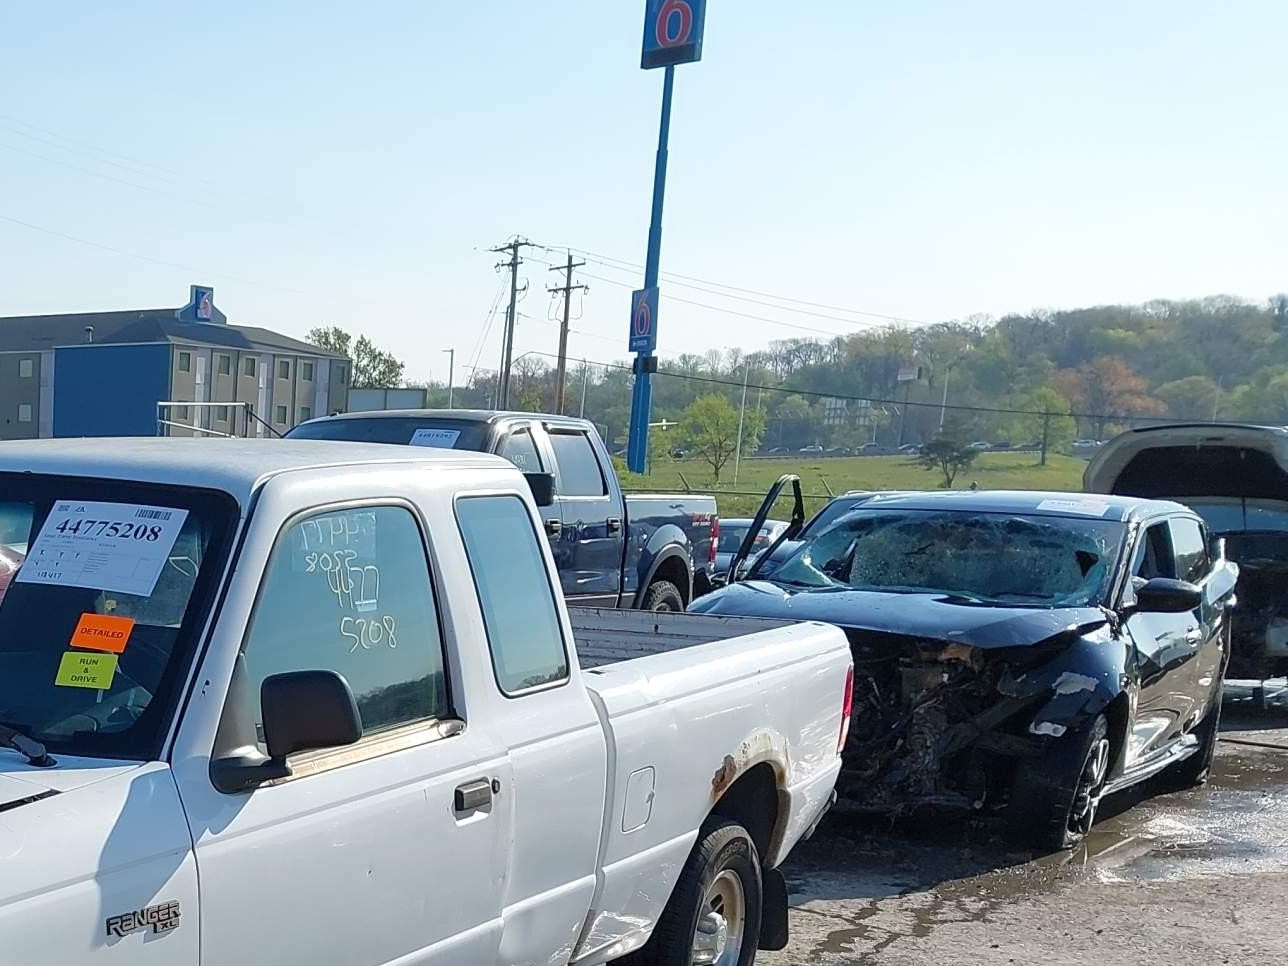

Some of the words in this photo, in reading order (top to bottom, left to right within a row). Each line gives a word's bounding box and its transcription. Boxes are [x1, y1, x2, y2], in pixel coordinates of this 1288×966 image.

[56, 518, 162, 542] 44775208
[80, 627, 124, 639] DETAILED
[340, 616, 398, 654] 5208
[79, 658, 99, 666] RUN
[70, 675, 98, 683] DRIVE
[106, 900, 181, 937] RANGER
